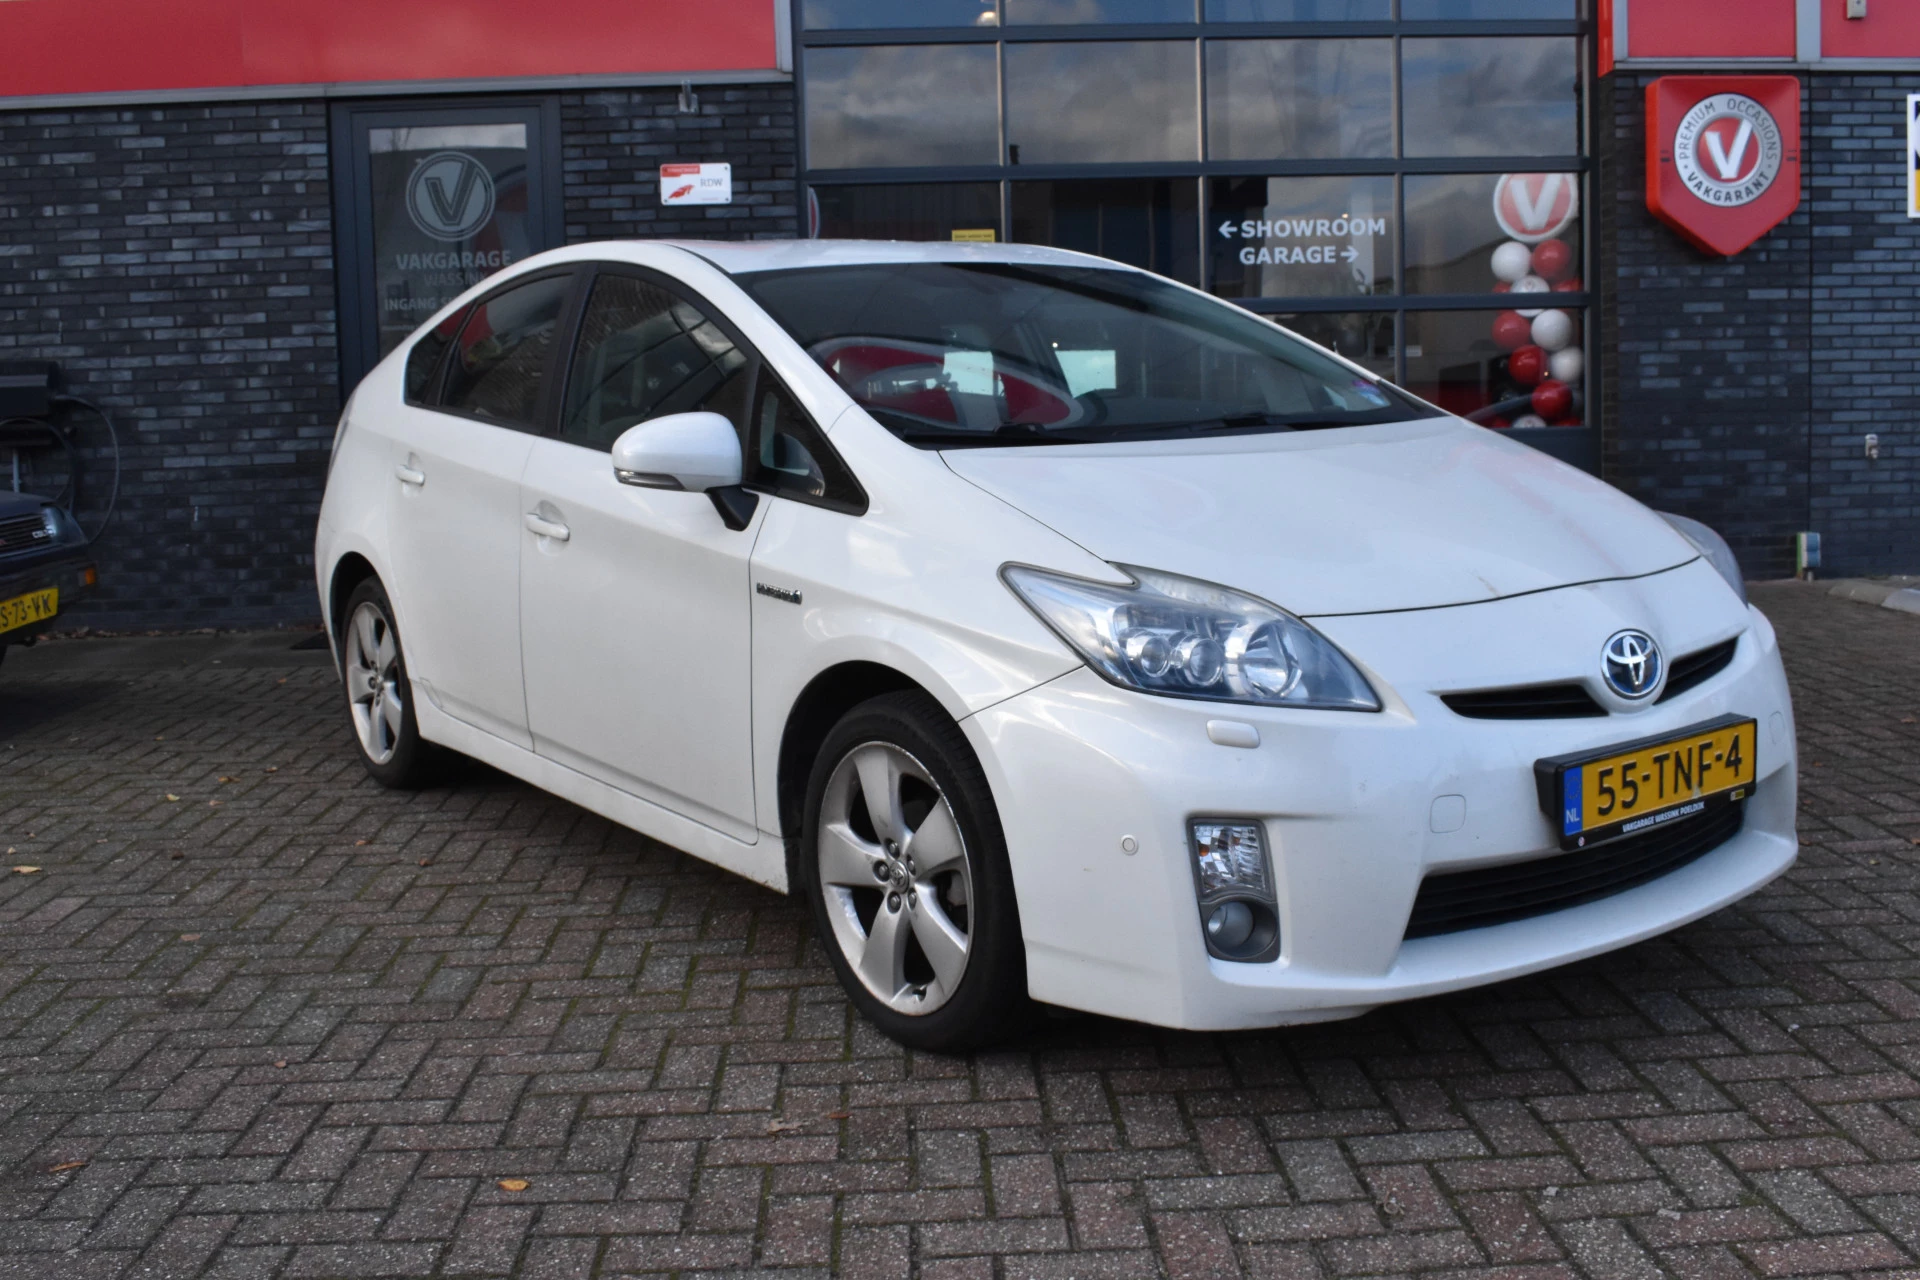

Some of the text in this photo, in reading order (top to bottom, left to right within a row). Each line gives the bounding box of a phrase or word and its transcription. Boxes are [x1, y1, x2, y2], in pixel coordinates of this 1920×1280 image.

[1679, 98, 1778, 161] PREMIUM OCCASIONS
[700, 177, 723, 188] RDW
[1686, 170, 1771, 203] VAKGARANT
[1241, 218, 1386, 238] SHOWROOM
[395, 250, 512, 271] VAKGARAGE
[1239, 245, 1337, 265] GARAGE
[384, 297, 436, 312] INGANG
[0, 593, 51, 628] S-73-VK
[1597, 733, 1742, 816] 55-TNF-4
[1565, 808, 1581, 824] NL
